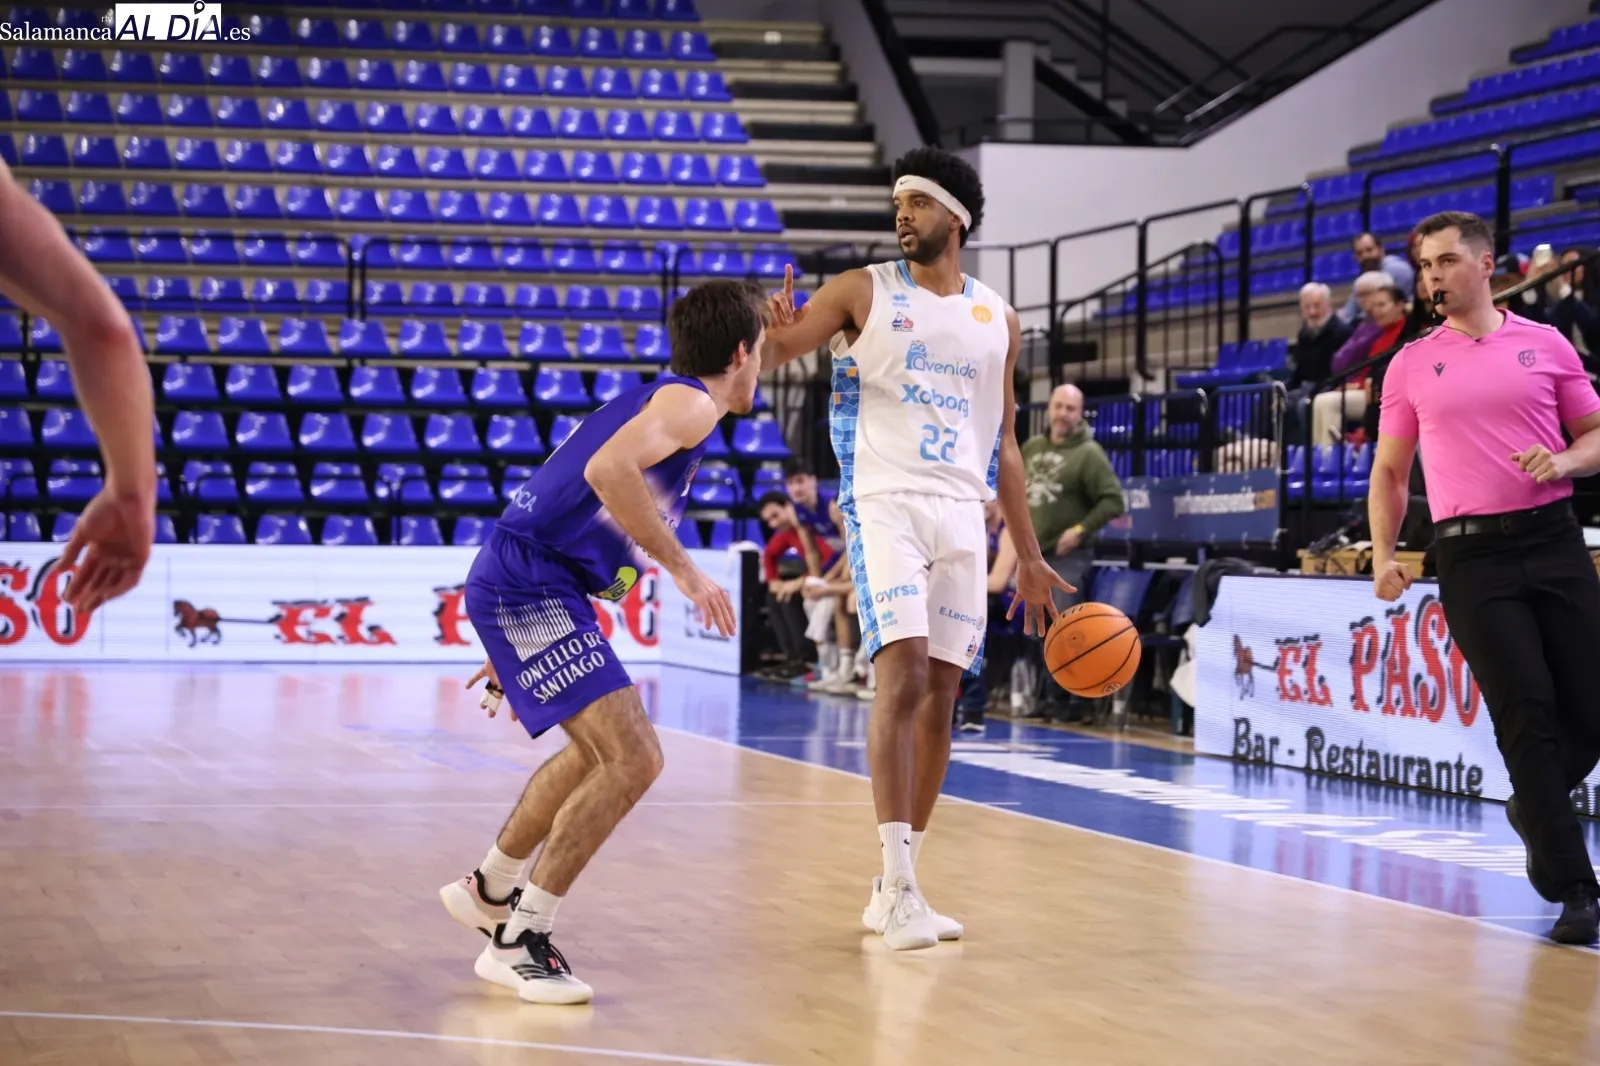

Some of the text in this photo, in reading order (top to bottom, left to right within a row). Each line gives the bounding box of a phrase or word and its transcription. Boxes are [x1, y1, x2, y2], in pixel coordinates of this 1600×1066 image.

[919, 424, 959, 464] 22
[269, 597, 397, 645] EL
[533, 652, 605, 704] SANTIAGO
[1275, 634, 1333, 706] EL
[1233, 717, 1280, 764] Bar
[1305, 726, 1483, 797] Restaurante
